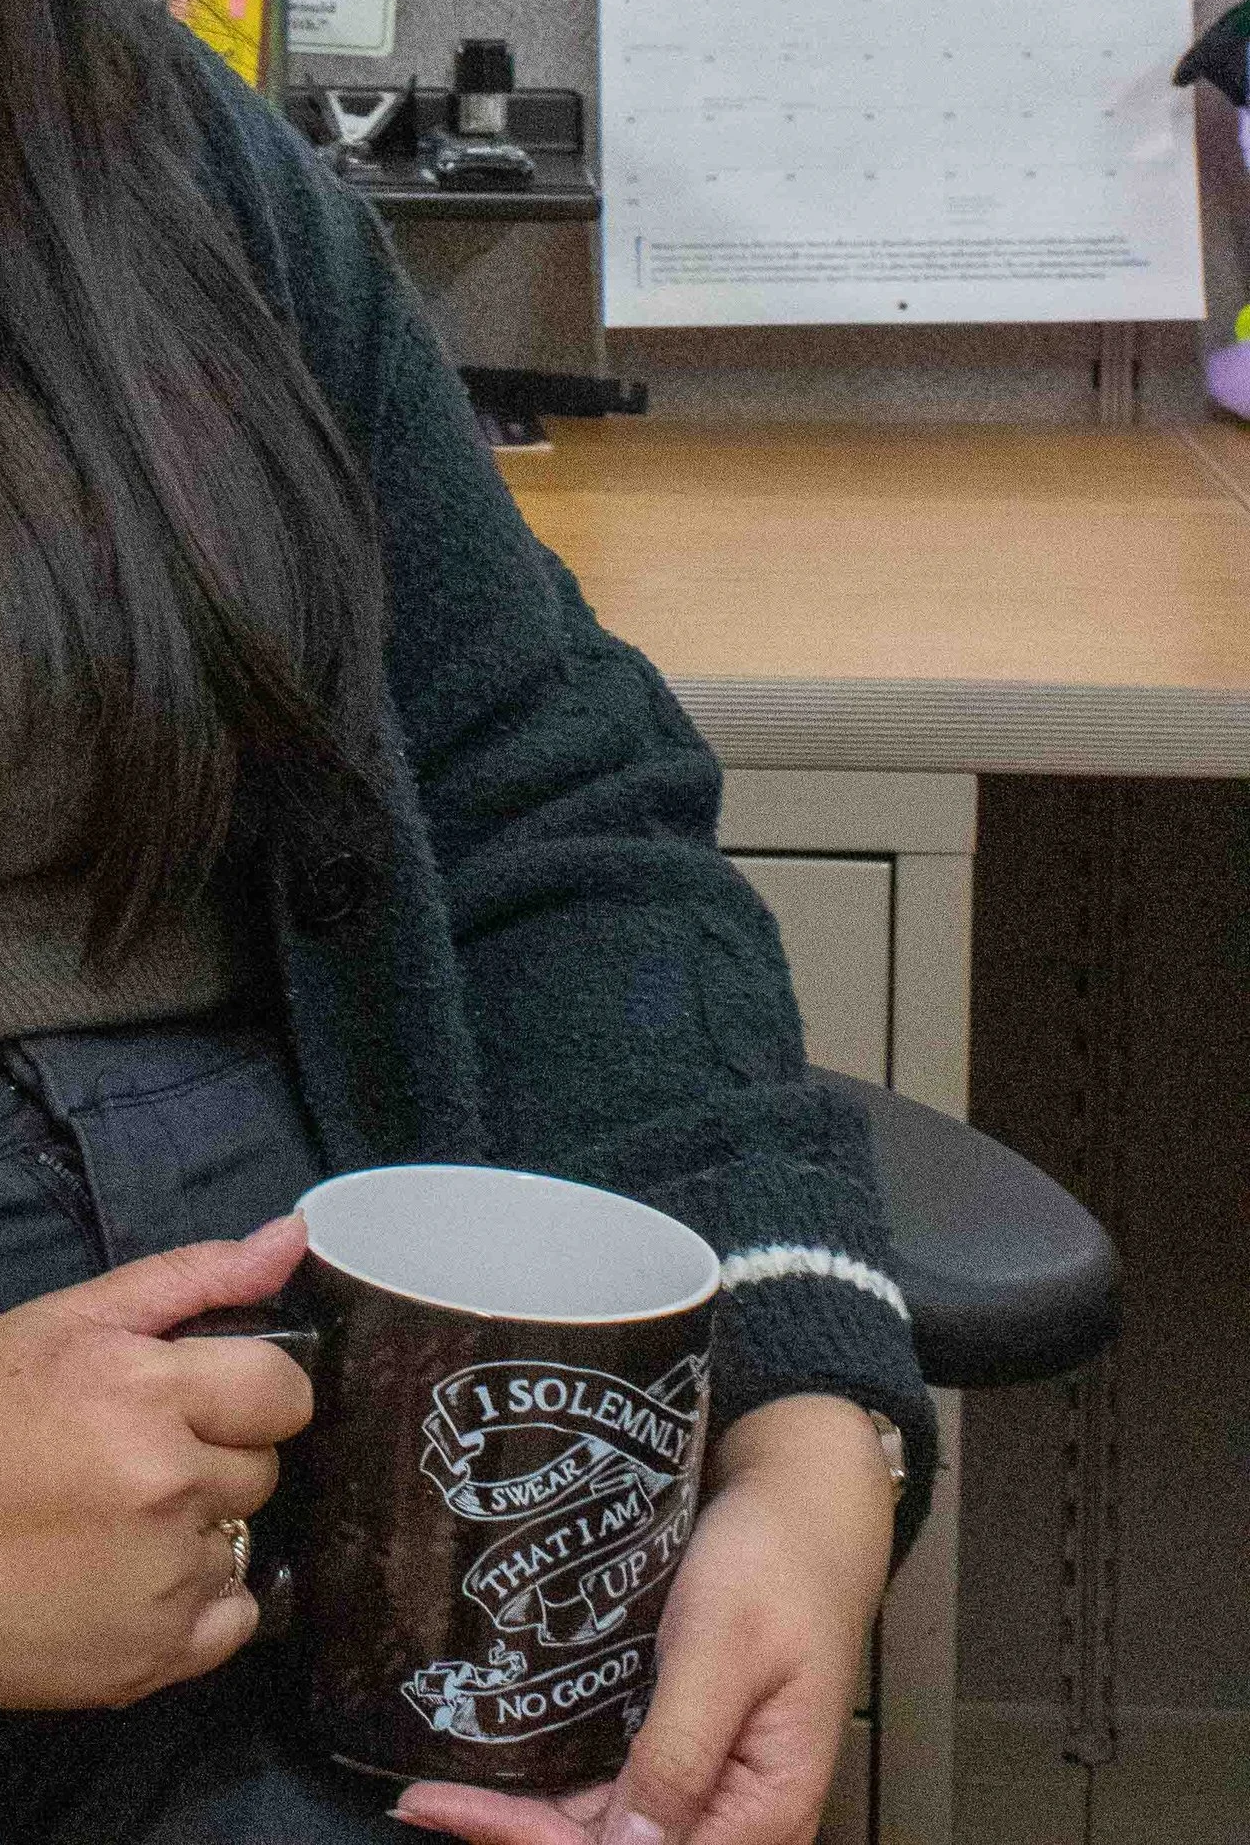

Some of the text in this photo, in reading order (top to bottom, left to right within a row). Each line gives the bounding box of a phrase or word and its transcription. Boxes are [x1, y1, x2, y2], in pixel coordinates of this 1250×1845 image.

[473, 1378, 691, 1465] I SOLEMNLY
[491, 1458, 584, 1511] SWEAR
[479, 1491, 643, 1598] THAT I AM
[601, 1508, 689, 1599] UP TO
[497, 1692, 547, 1724] NO
